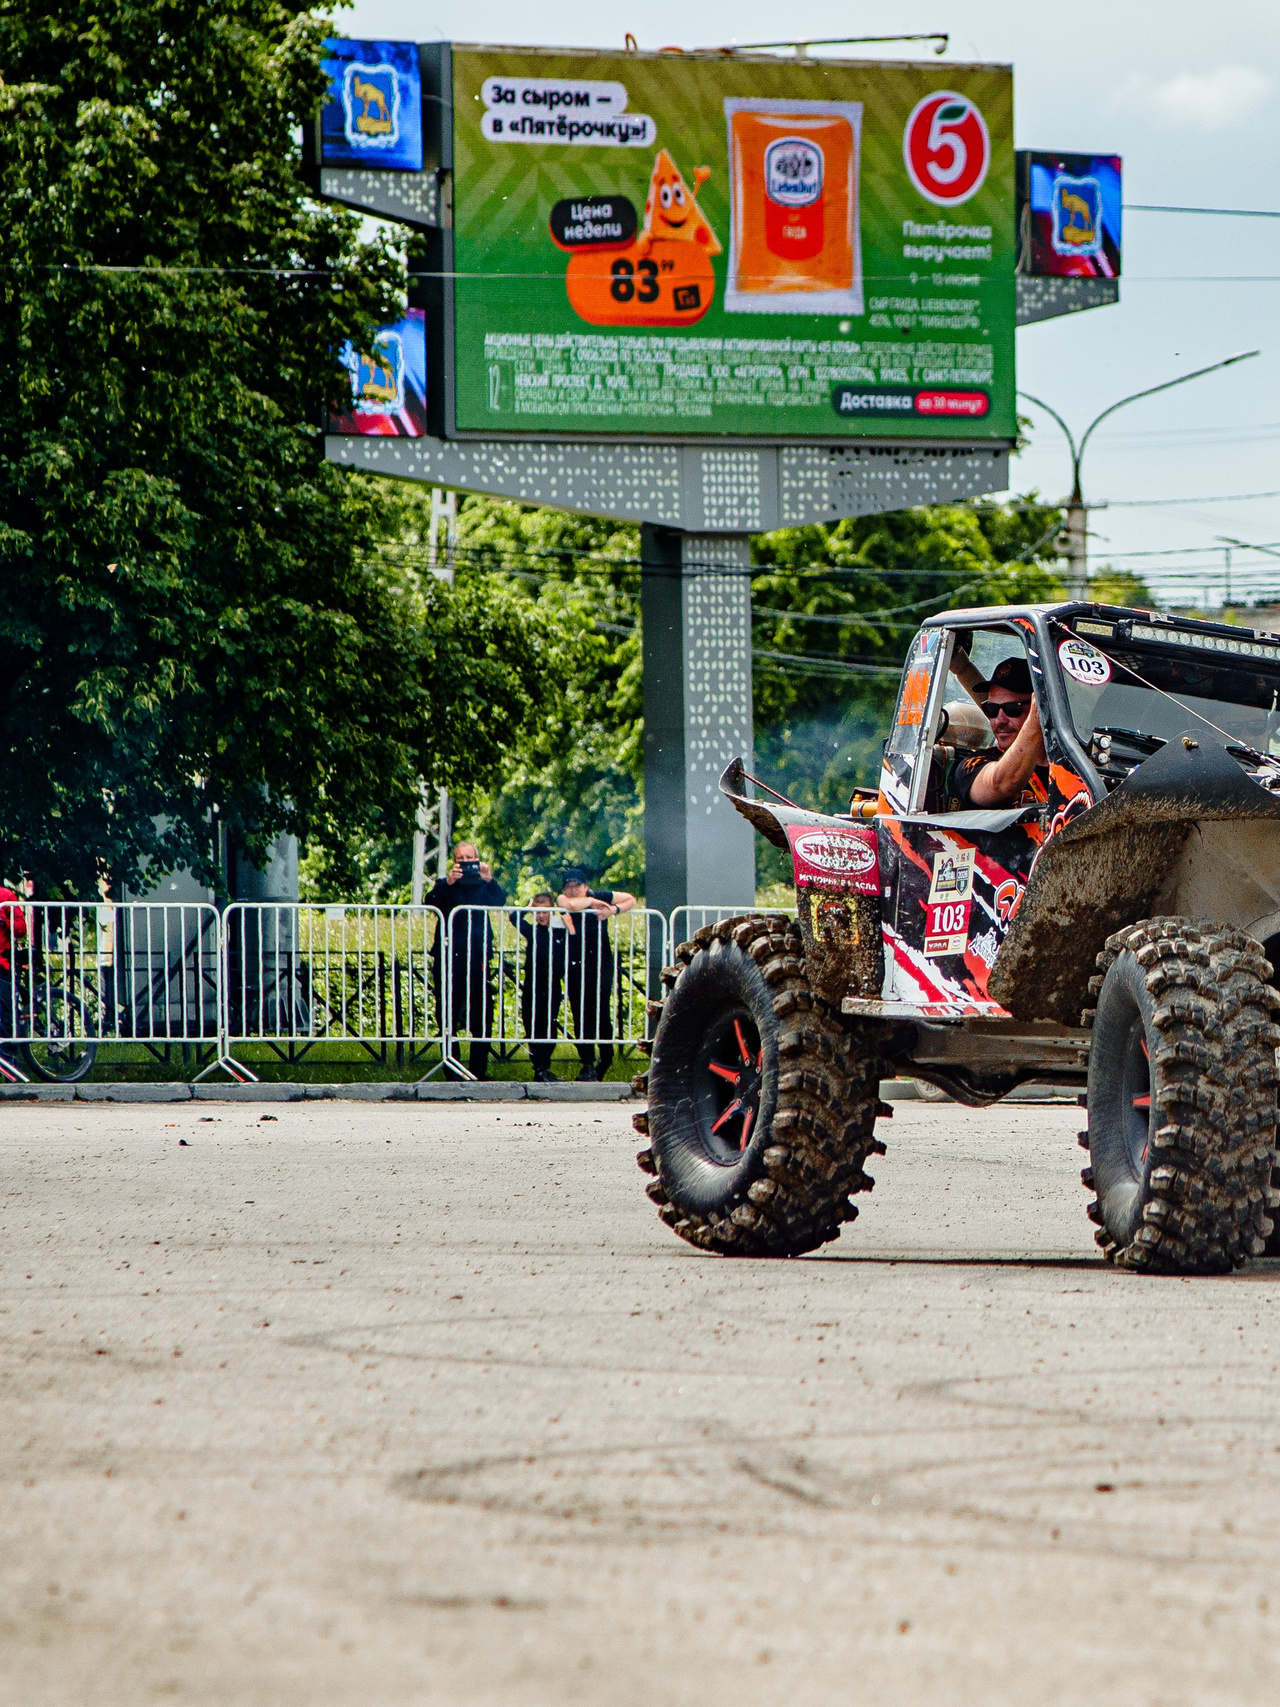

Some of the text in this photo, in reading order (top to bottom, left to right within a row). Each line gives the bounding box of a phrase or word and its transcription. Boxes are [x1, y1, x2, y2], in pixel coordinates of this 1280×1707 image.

[491, 84, 516, 104] За
[522, 88, 590, 110] сыром
[492, 118, 503, 133] в
[570, 203, 613, 221] Цена
[564, 220, 623, 240] недели
[902, 219, 991, 242] Пятёрочка
[902, 243, 992, 263] выручает!
[610, 257, 660, 303] 83
[840, 391, 912, 411] Доставка
[1066, 656, 1105, 676] 103
[802, 843, 869, 863] SINTEC
[931, 903, 966, 934] 103
